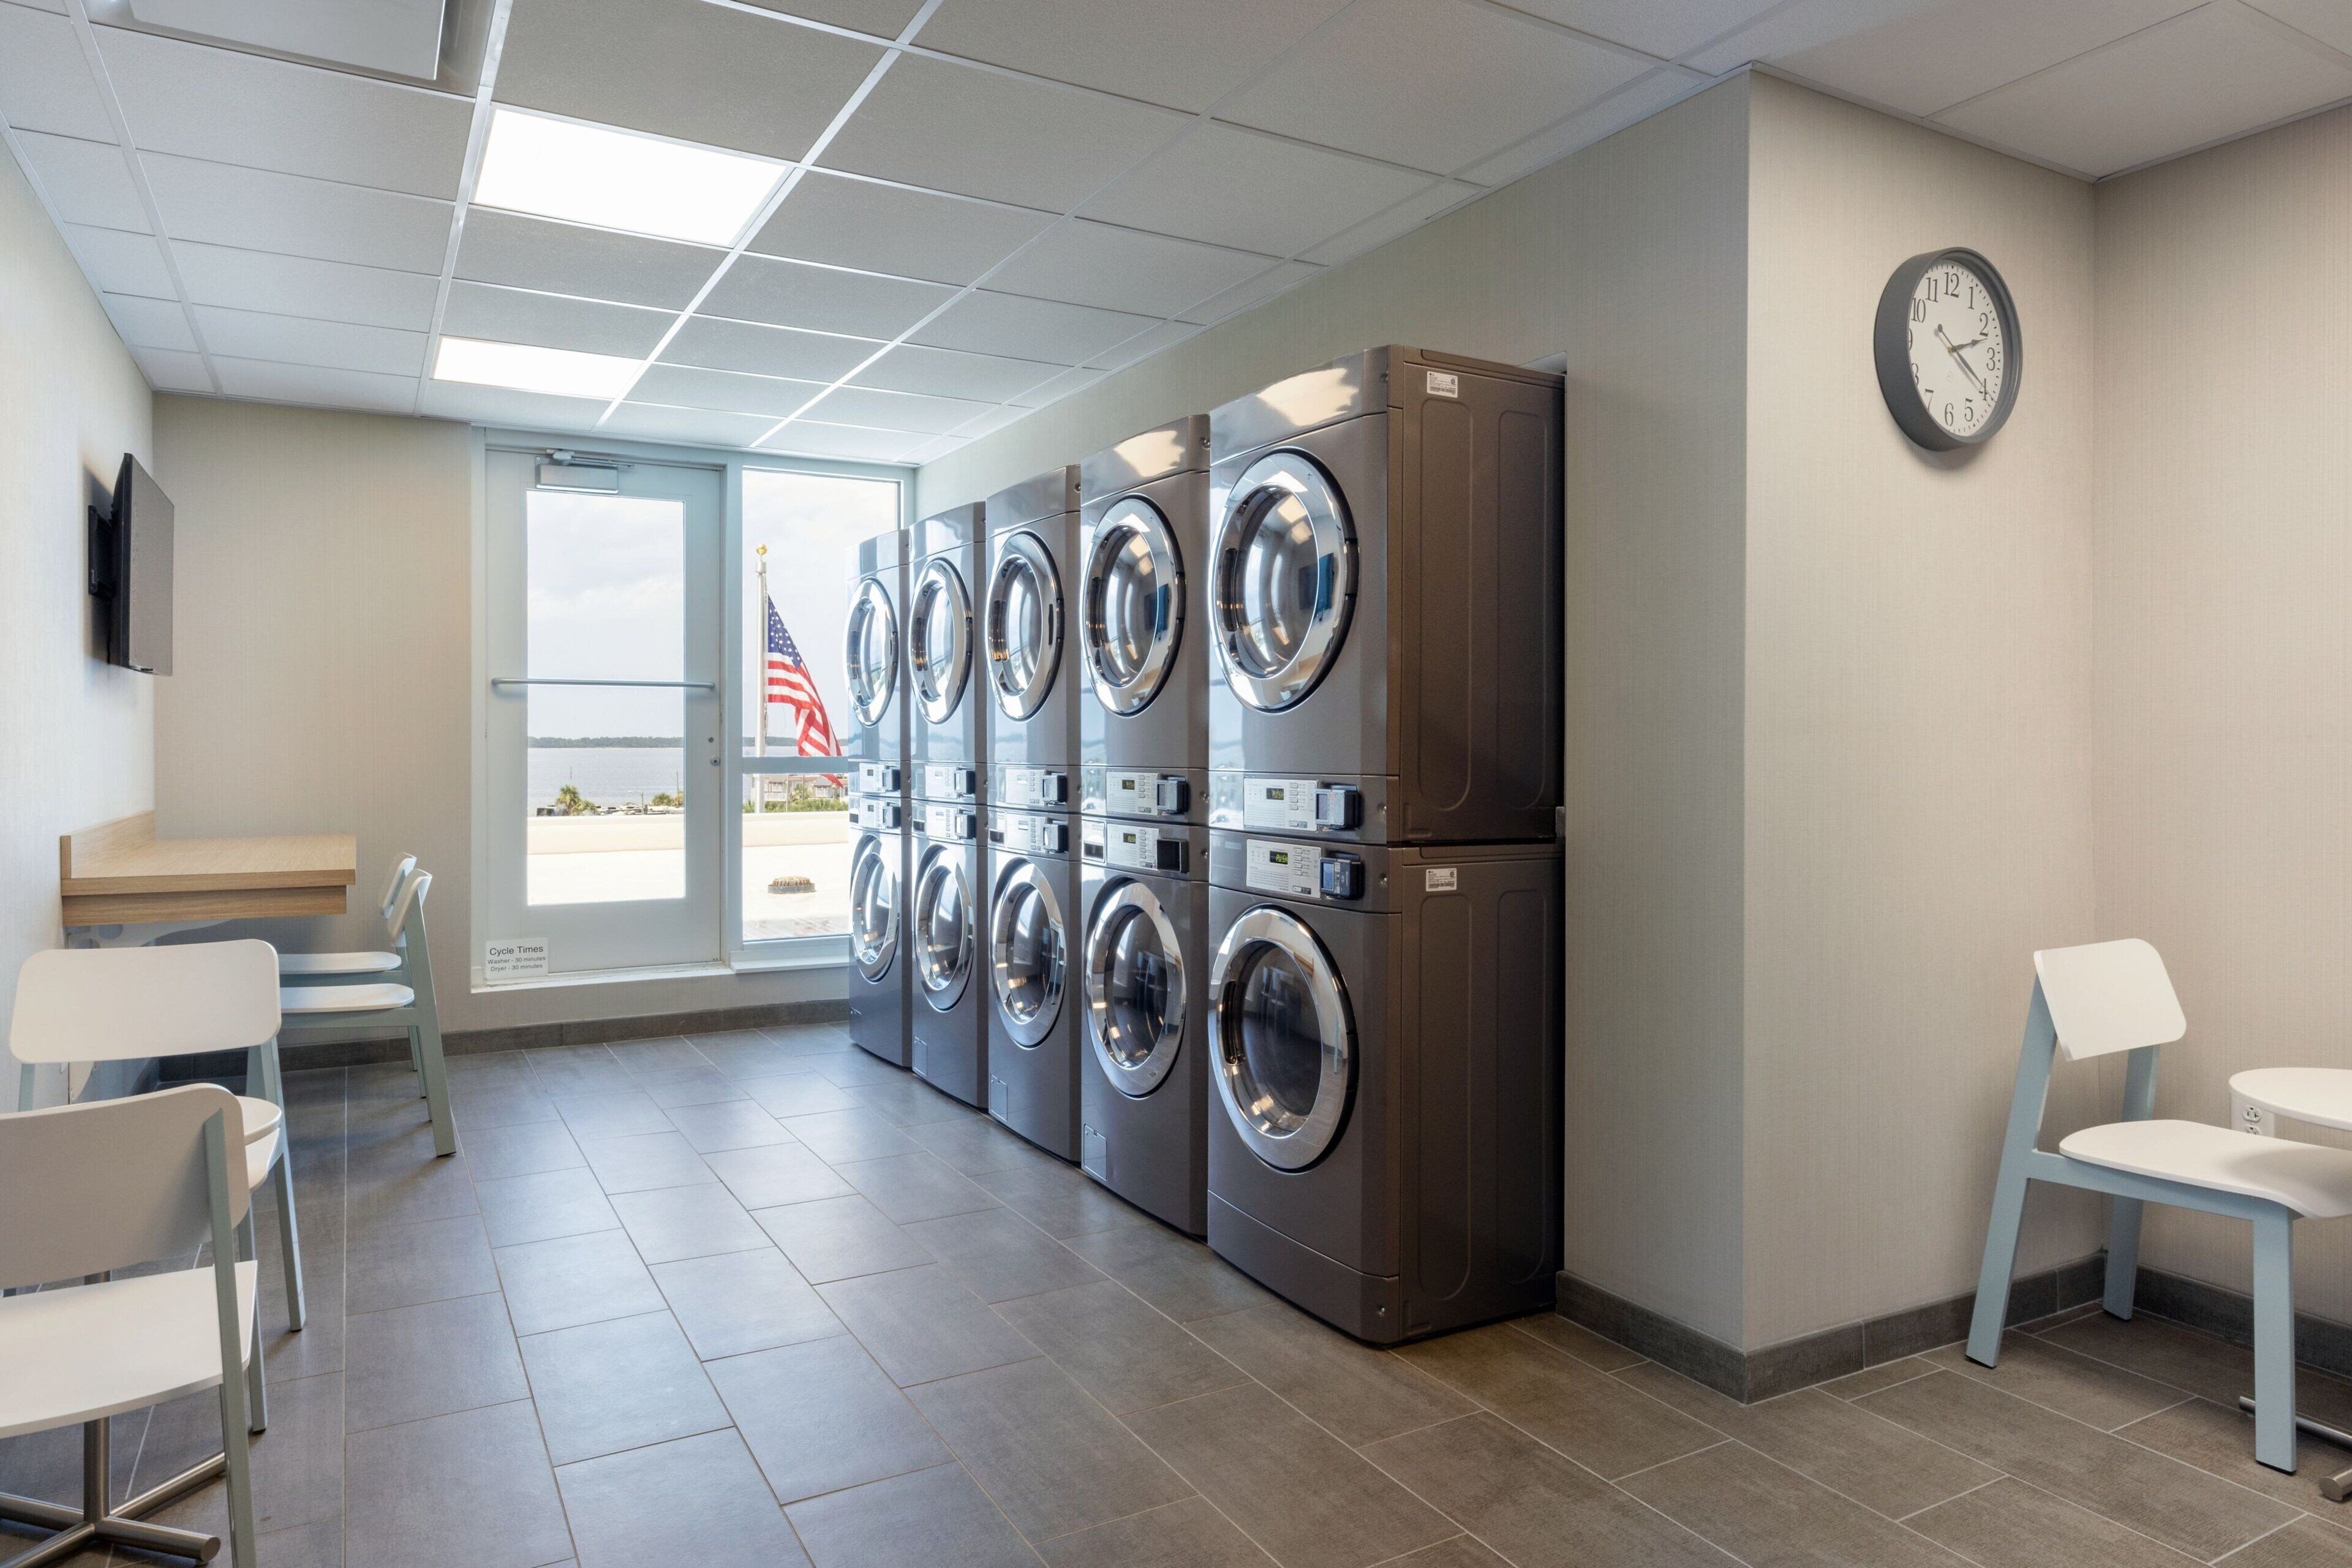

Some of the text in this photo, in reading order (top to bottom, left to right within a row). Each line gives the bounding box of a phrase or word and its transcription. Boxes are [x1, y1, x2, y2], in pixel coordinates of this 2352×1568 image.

[1925, 277, 1939, 303] 11
[1943, 272, 1960, 298] 12
[1967, 286, 1975, 310] 1
[1910, 298, 1926, 323] 10
[1980, 312, 1989, 337] 2
[1986, 347, 1996, 371] 3
[1924, 388, 1934, 411] 7
[1978, 378, 1988, 401] 4
[1944, 402, 1954, 426] 6
[1964, 398, 1974, 422] 5
[489, 947, 514, 957] Cycle
